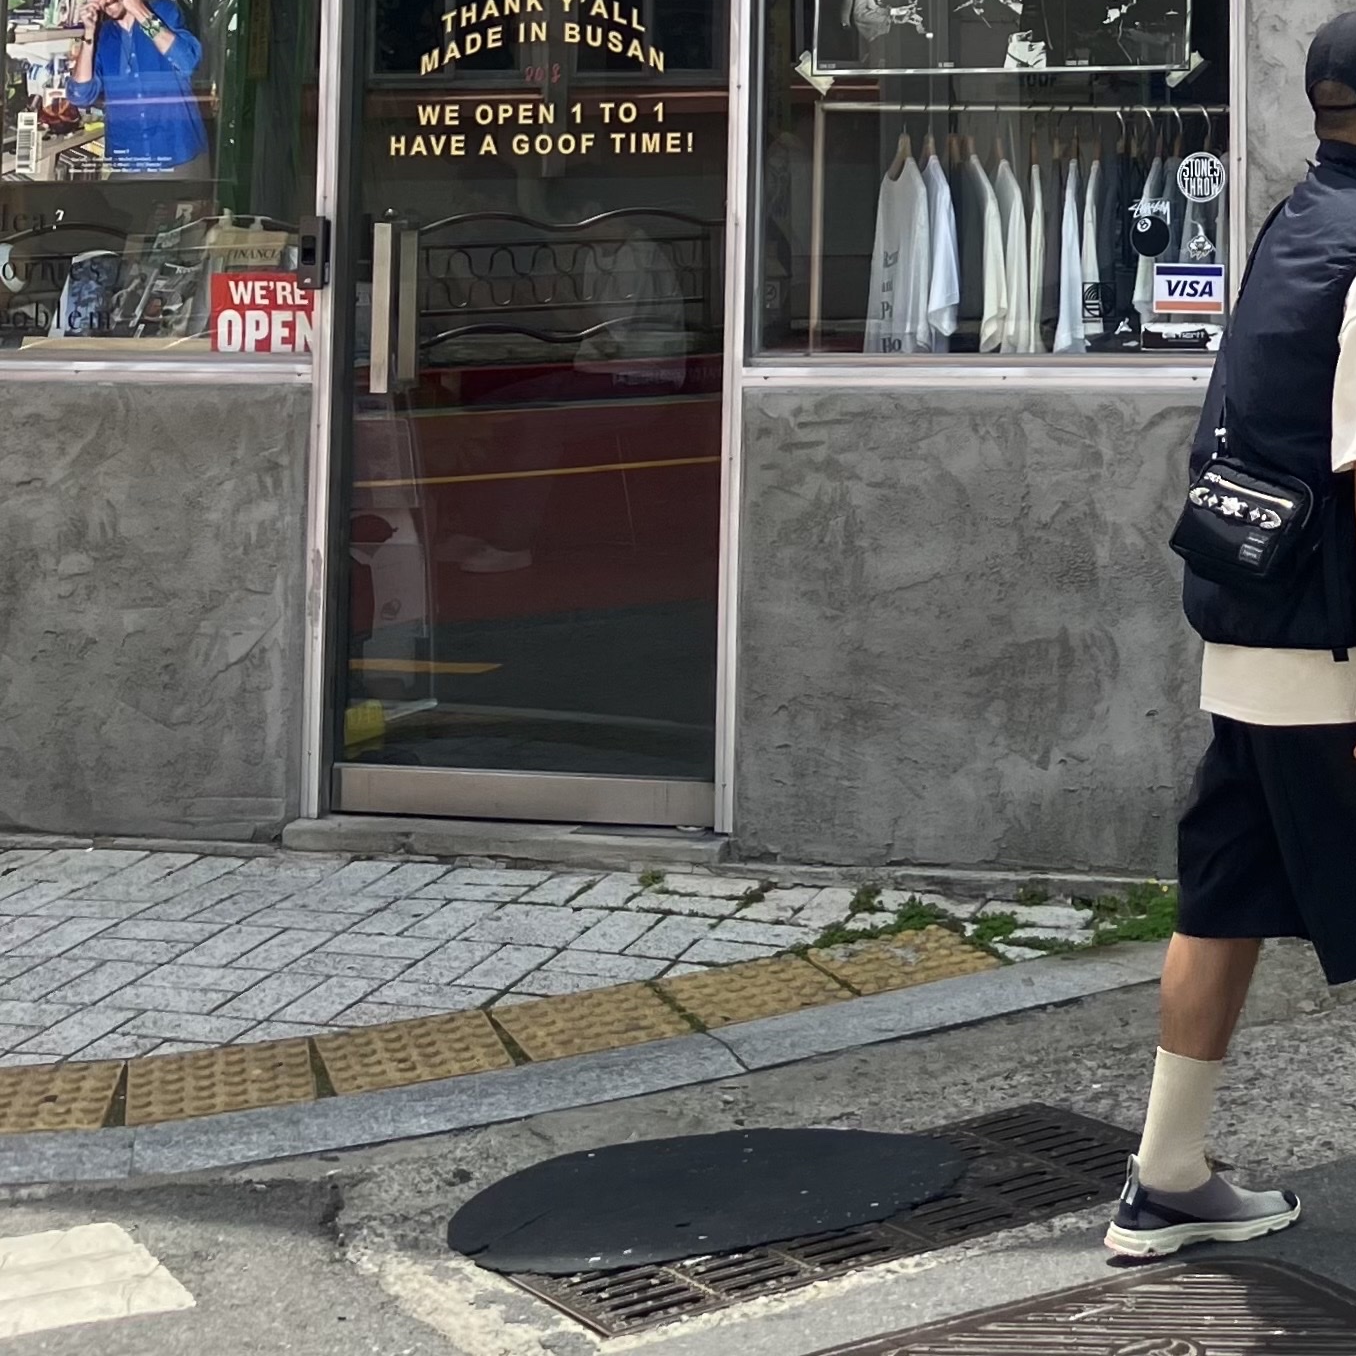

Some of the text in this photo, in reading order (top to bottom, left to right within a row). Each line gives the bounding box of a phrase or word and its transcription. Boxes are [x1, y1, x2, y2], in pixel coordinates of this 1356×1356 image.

[420, 25, 503, 76] MADE
[518, 21, 548, 43] IN
[563, 22, 665, 74] BUSAN
[417, 101, 664, 126] WE OPEN 1 TO 1
[390, 132, 694, 156] HAVE A GOOF TIME!
[1182, 157, 1220, 179] STONES
[1183, 177, 1219, 196] THROW
[228, 280, 309, 306] WE'RE
[1165, 279, 1214, 298] VISA
[216, 308, 314, 353] OPEN
